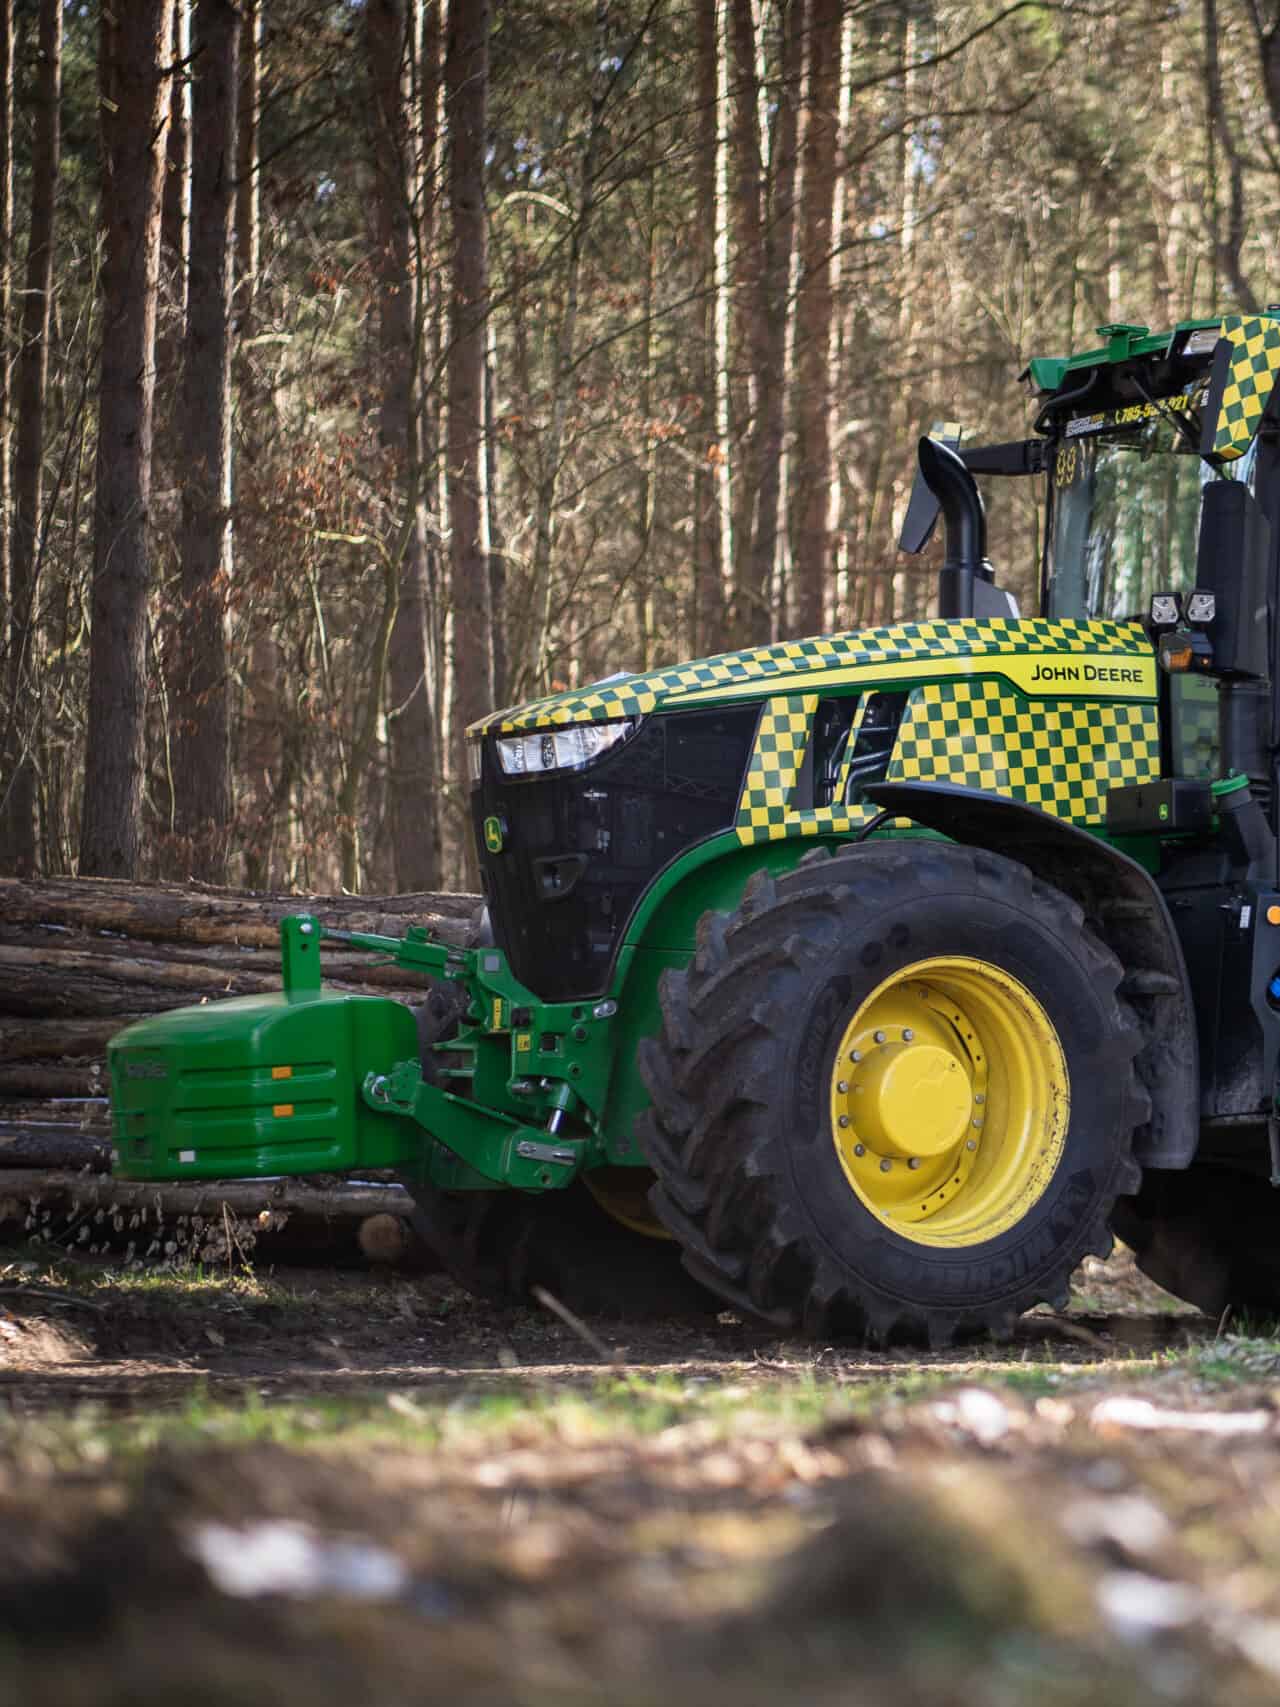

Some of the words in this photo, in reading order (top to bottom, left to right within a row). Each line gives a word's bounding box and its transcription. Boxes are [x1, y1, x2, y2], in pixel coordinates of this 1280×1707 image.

[1055, 446, 1077, 488] 99
[1031, 664, 1080, 681] JOHN
[1084, 665, 1144, 682] DEERE
